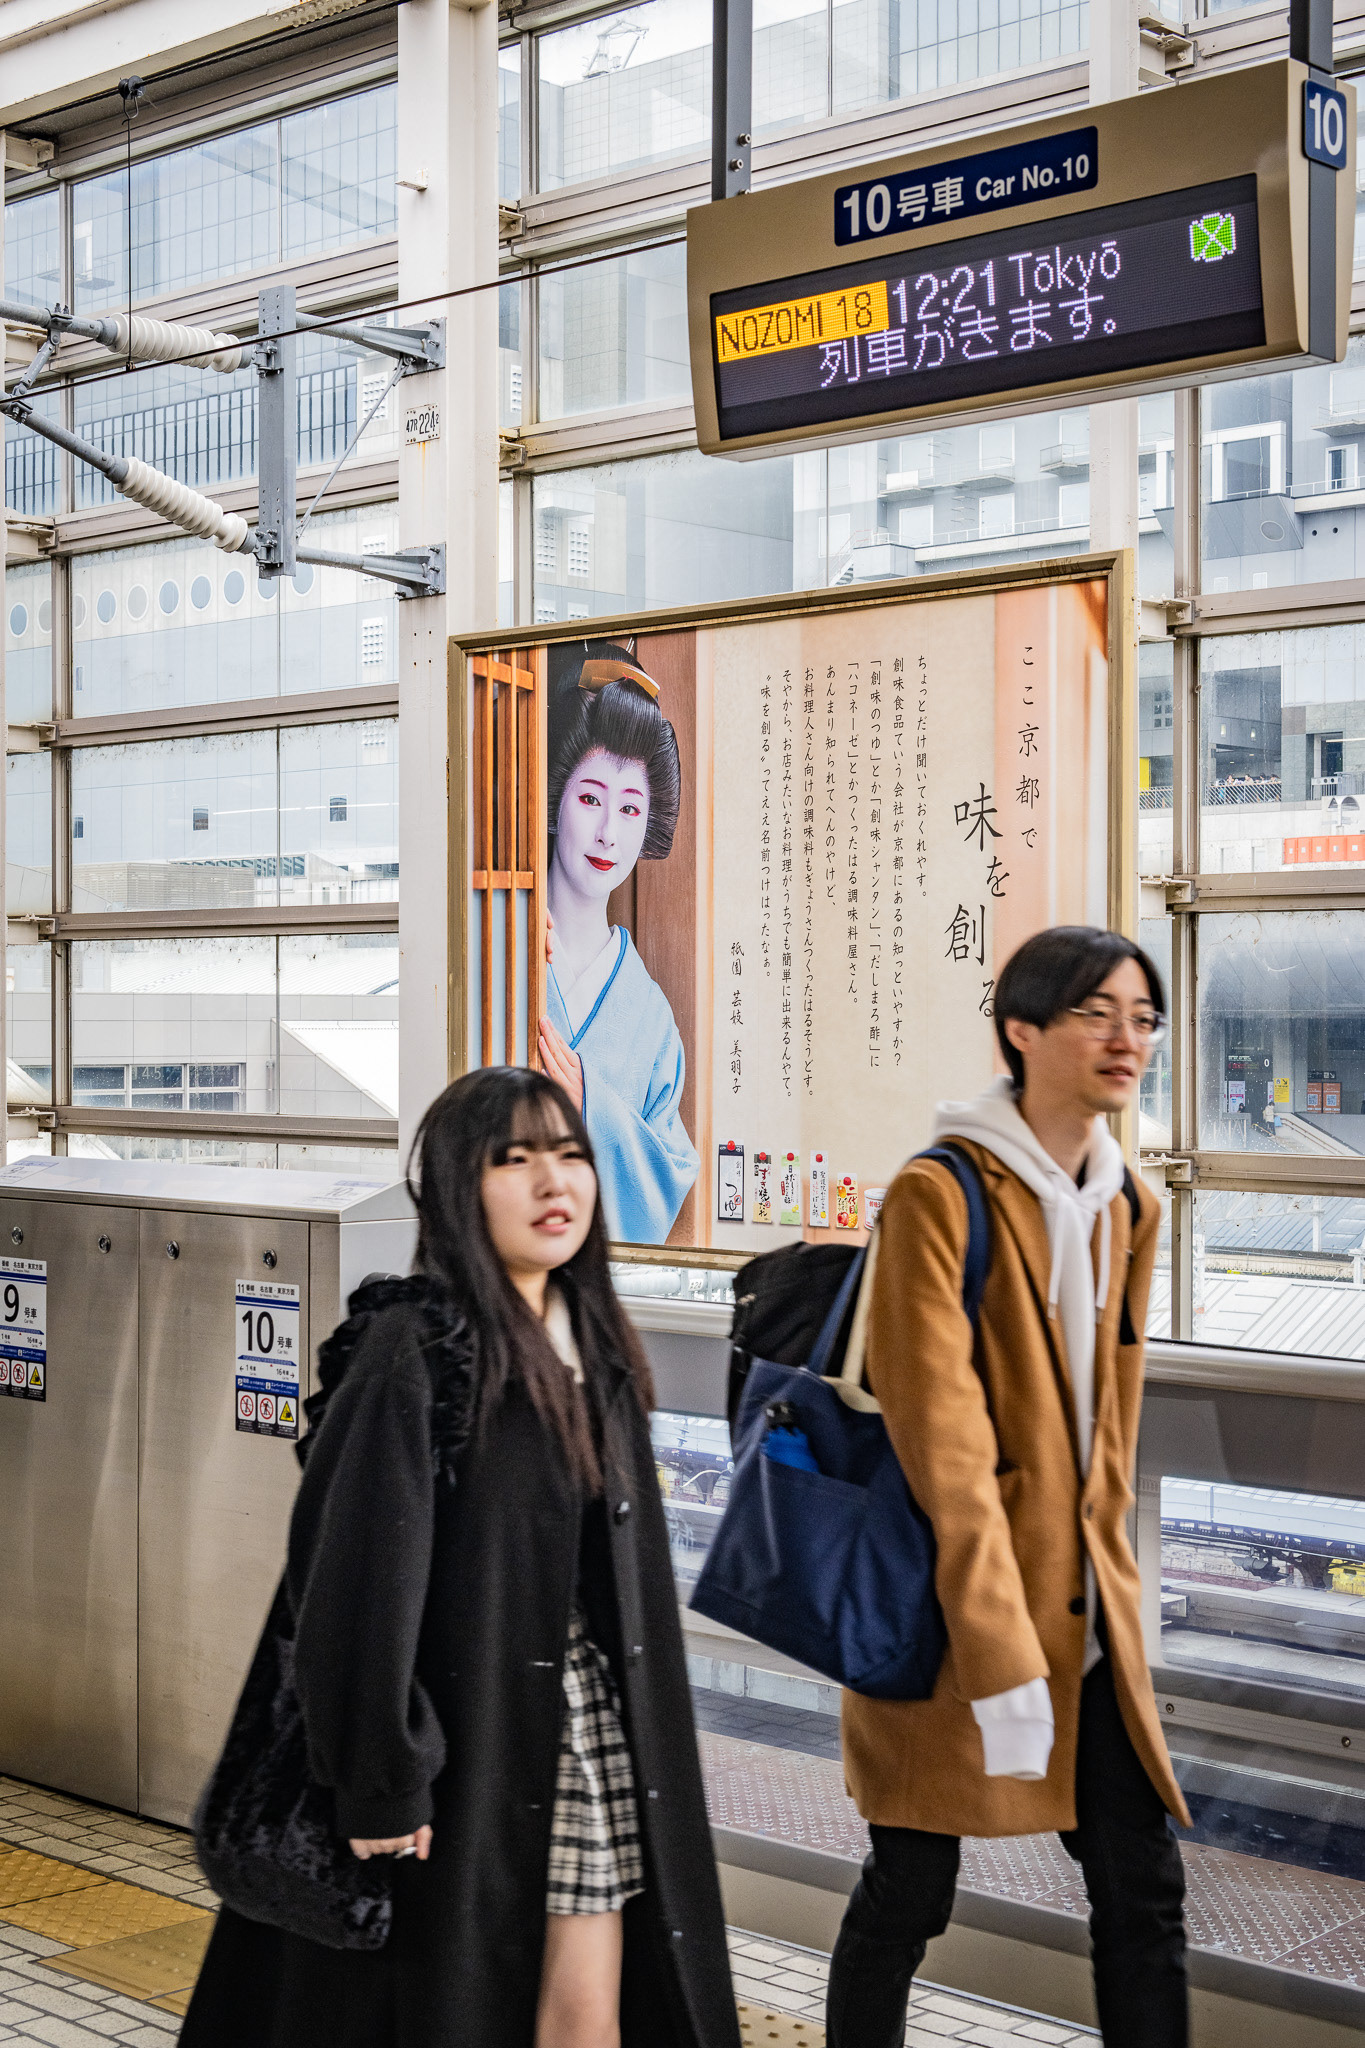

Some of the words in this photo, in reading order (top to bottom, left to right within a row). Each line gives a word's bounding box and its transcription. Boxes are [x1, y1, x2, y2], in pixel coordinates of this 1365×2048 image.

[1309, 92, 1343, 156] 10
[842, 176, 965, 238] 10号車
[975, 175, 1015, 202] Car
[1022, 153, 1090, 192] No.10
[720, 300, 823, 357] NOZOMI
[836, 290, 873, 333] 18
[892, 260, 996, 321] 12:21
[818, 289, 1117, 387] 列車がきます。
[826, 665, 835, 905] あんまり知られてへんのやけど、
[917, 656, 927, 896] ちょっとだけ聞いておくれやす。
[1016, 647, 1039, 848] ここ京都で
[848, 663, 858, 1002] 「ハコネーゼ」とかつくったはる調味料屋さん。
[3, 1284, 20, 1323] 9
[24, 1307, 38, 1319] 号車
[241, 1310, 275, 1354] 10
[277, 1336, 293, 1350] 号車
